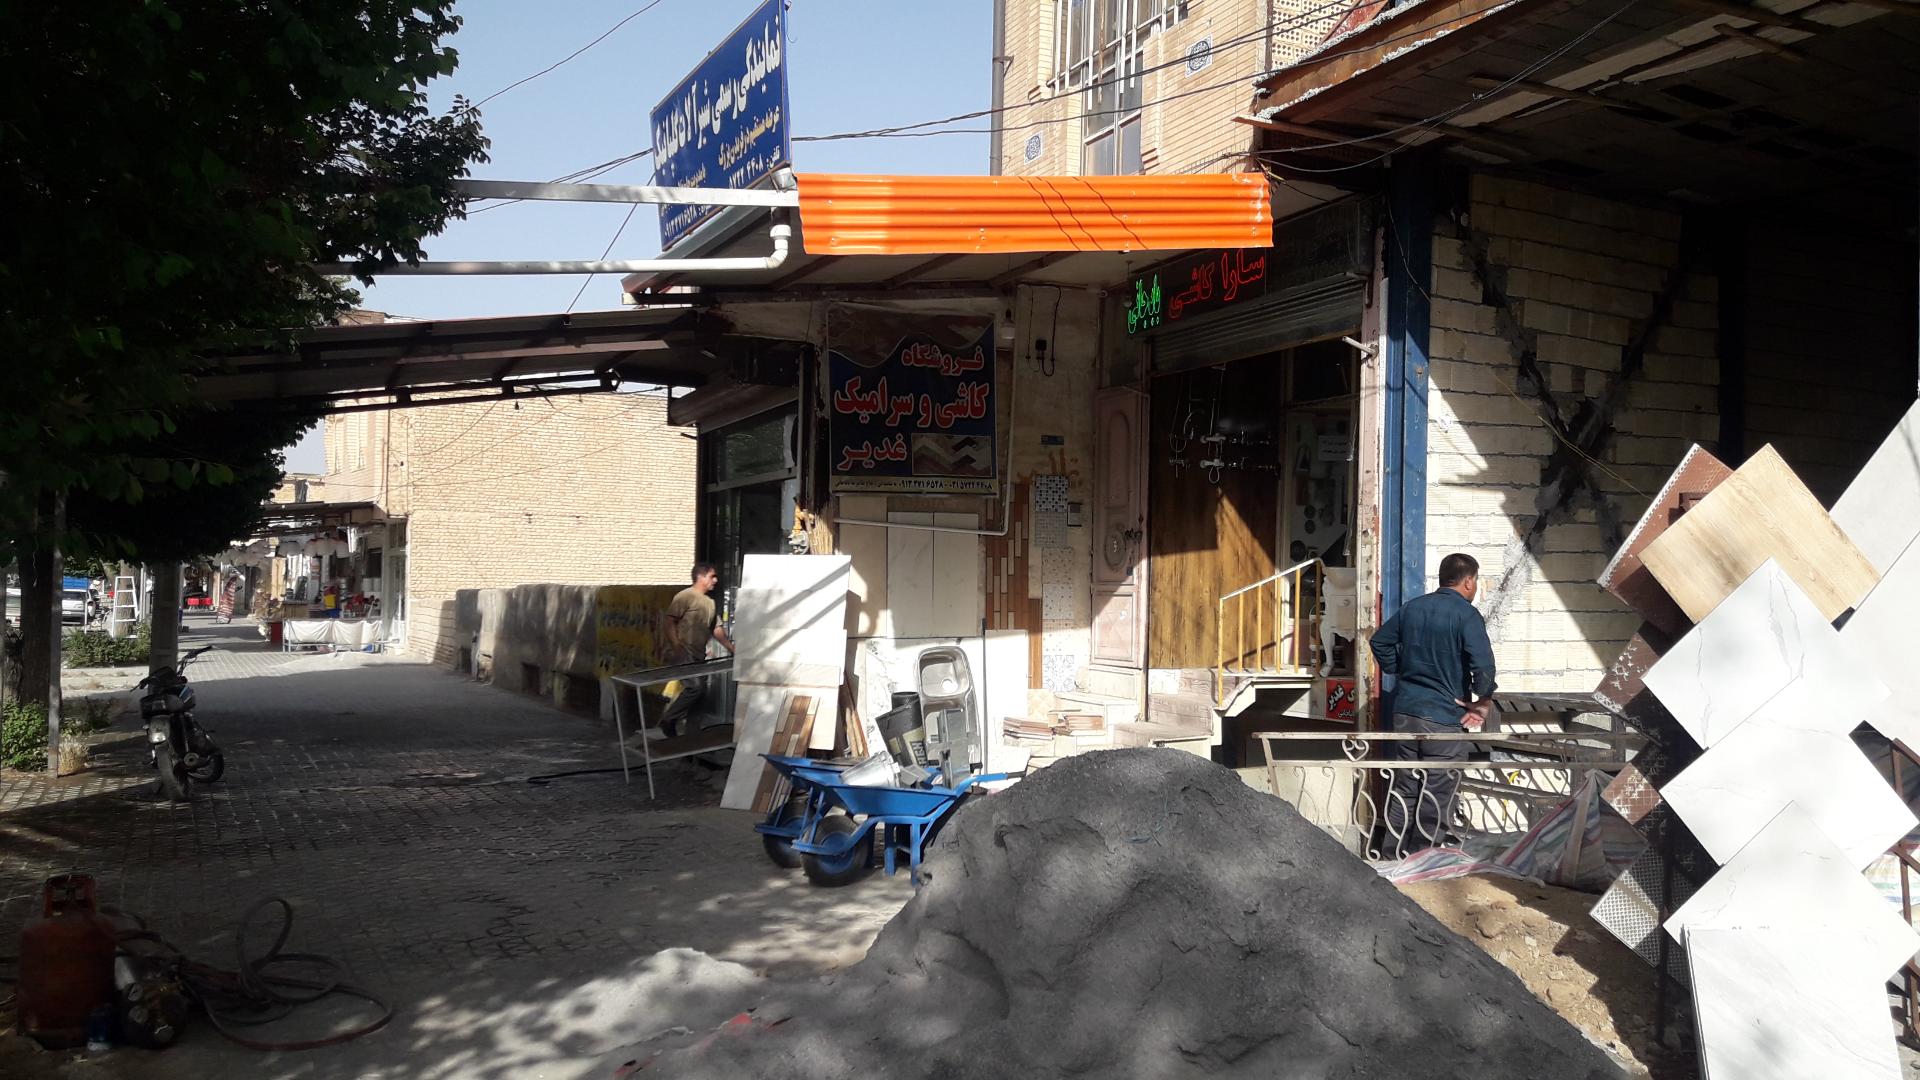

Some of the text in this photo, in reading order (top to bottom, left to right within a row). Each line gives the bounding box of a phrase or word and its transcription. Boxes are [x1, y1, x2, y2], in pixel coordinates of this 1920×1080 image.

[738, 14, 781, 112] نمایندگی
[712, 76, 739, 135] رسمی
[1168, 261, 1216, 319] کاشی
[1221, 248, 1264, 301] سارا
[901, 342, 984, 376] فروشگاه
[834, 376, 990, 429] کاشی و سرامیک
[837, 432, 907, 471] غدیر
